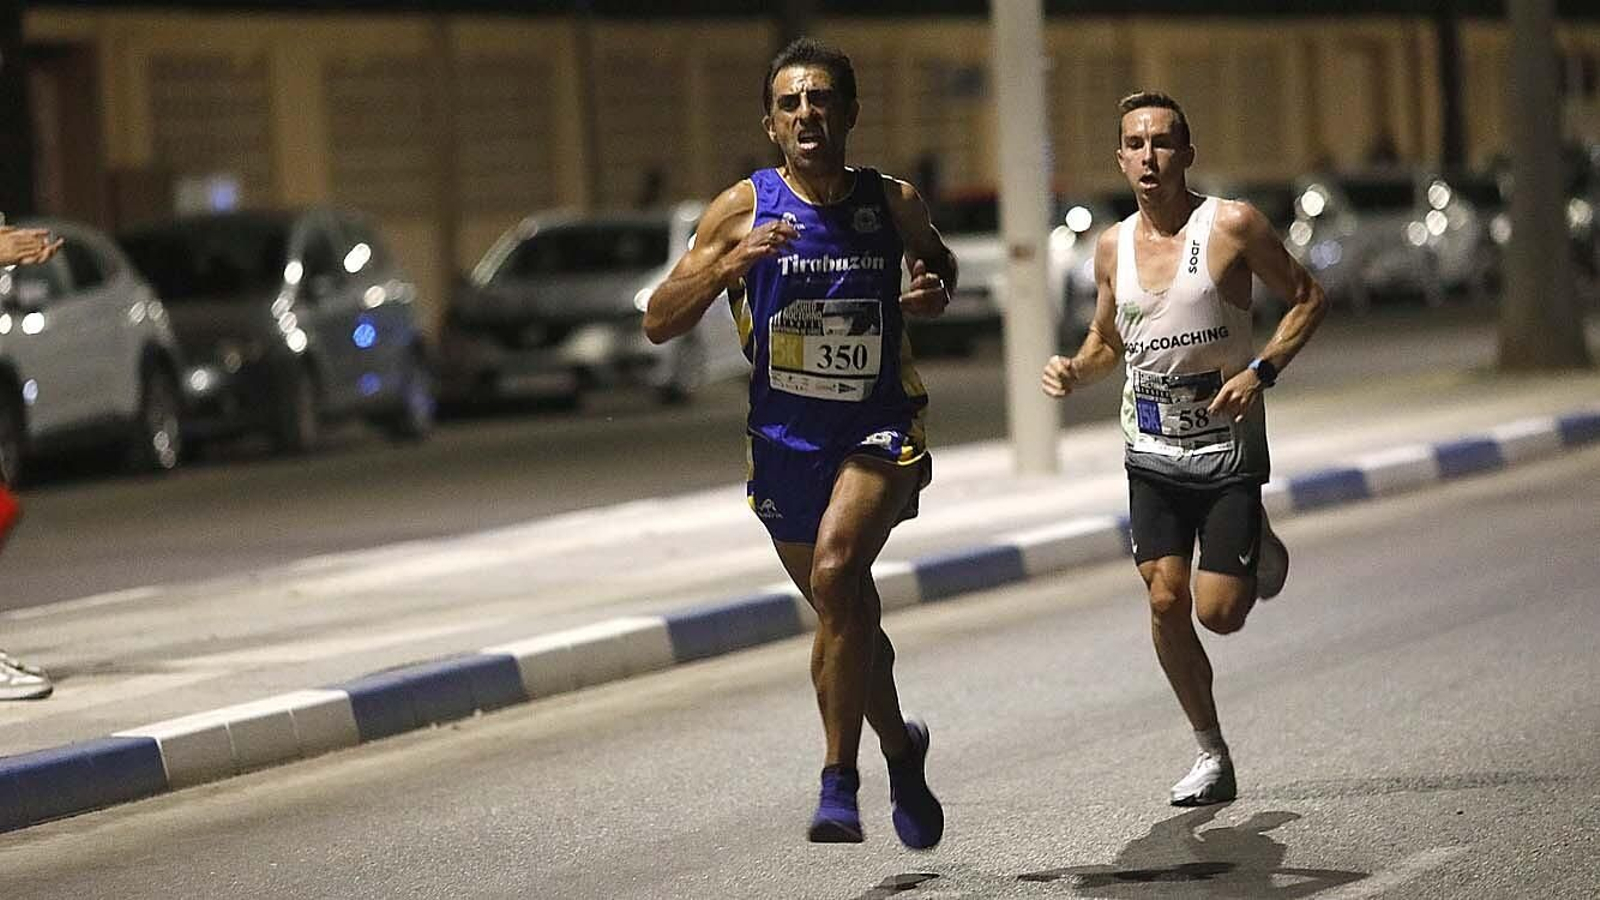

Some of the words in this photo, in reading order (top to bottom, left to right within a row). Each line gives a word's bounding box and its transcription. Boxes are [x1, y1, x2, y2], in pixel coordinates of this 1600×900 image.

[777, 252, 885, 276] Tirabuzón
[1188, 240, 1200, 274] soar
[816, 343, 868, 371] 350
[1179, 407, 1209, 431] 58
